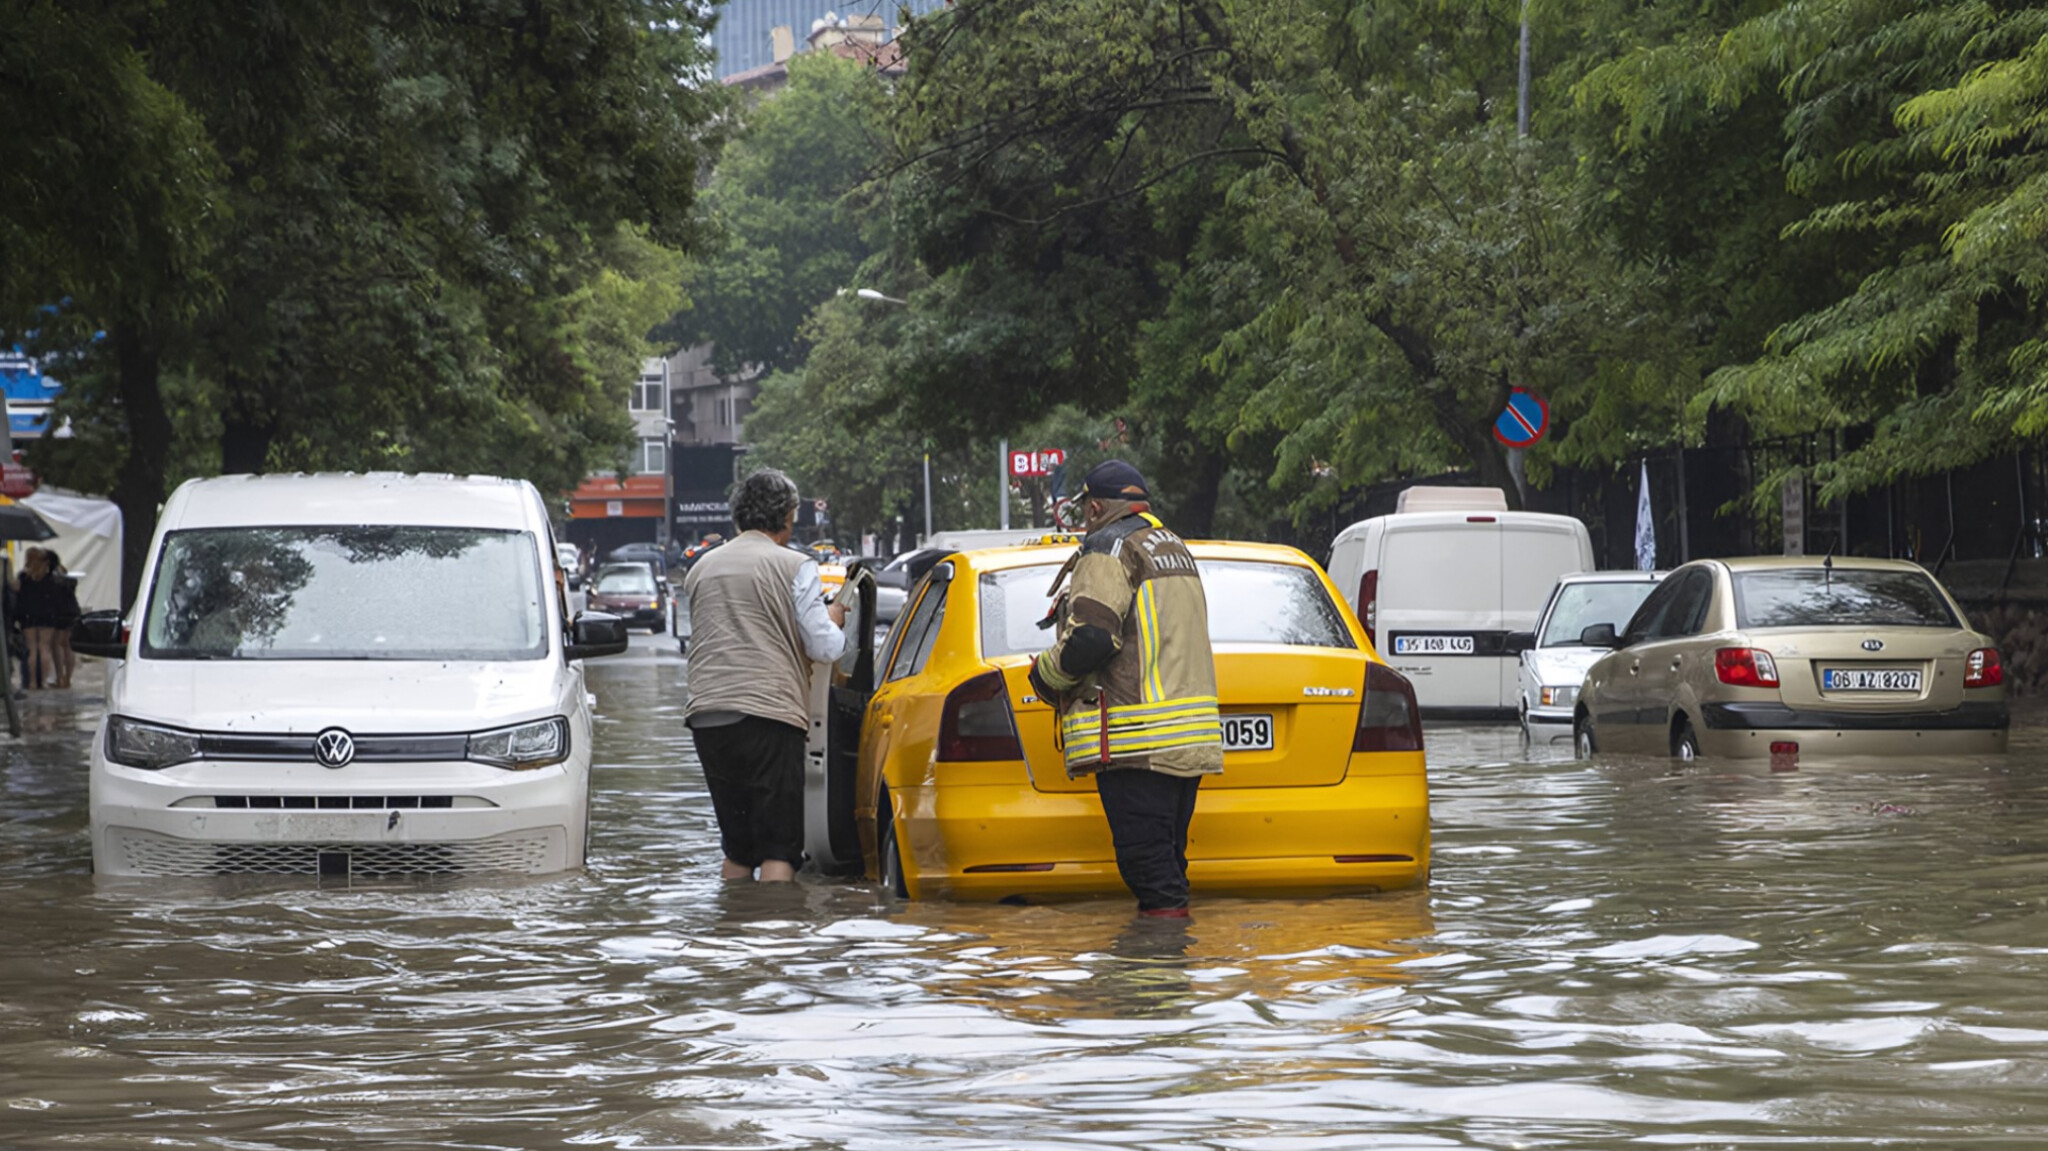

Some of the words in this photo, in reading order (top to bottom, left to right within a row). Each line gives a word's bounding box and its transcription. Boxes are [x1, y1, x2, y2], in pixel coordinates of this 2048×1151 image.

[1859, 672, 1877, 688] AZ
[1882, 672, 1919, 688] 8207
[1220, 718, 1269, 747] 059
